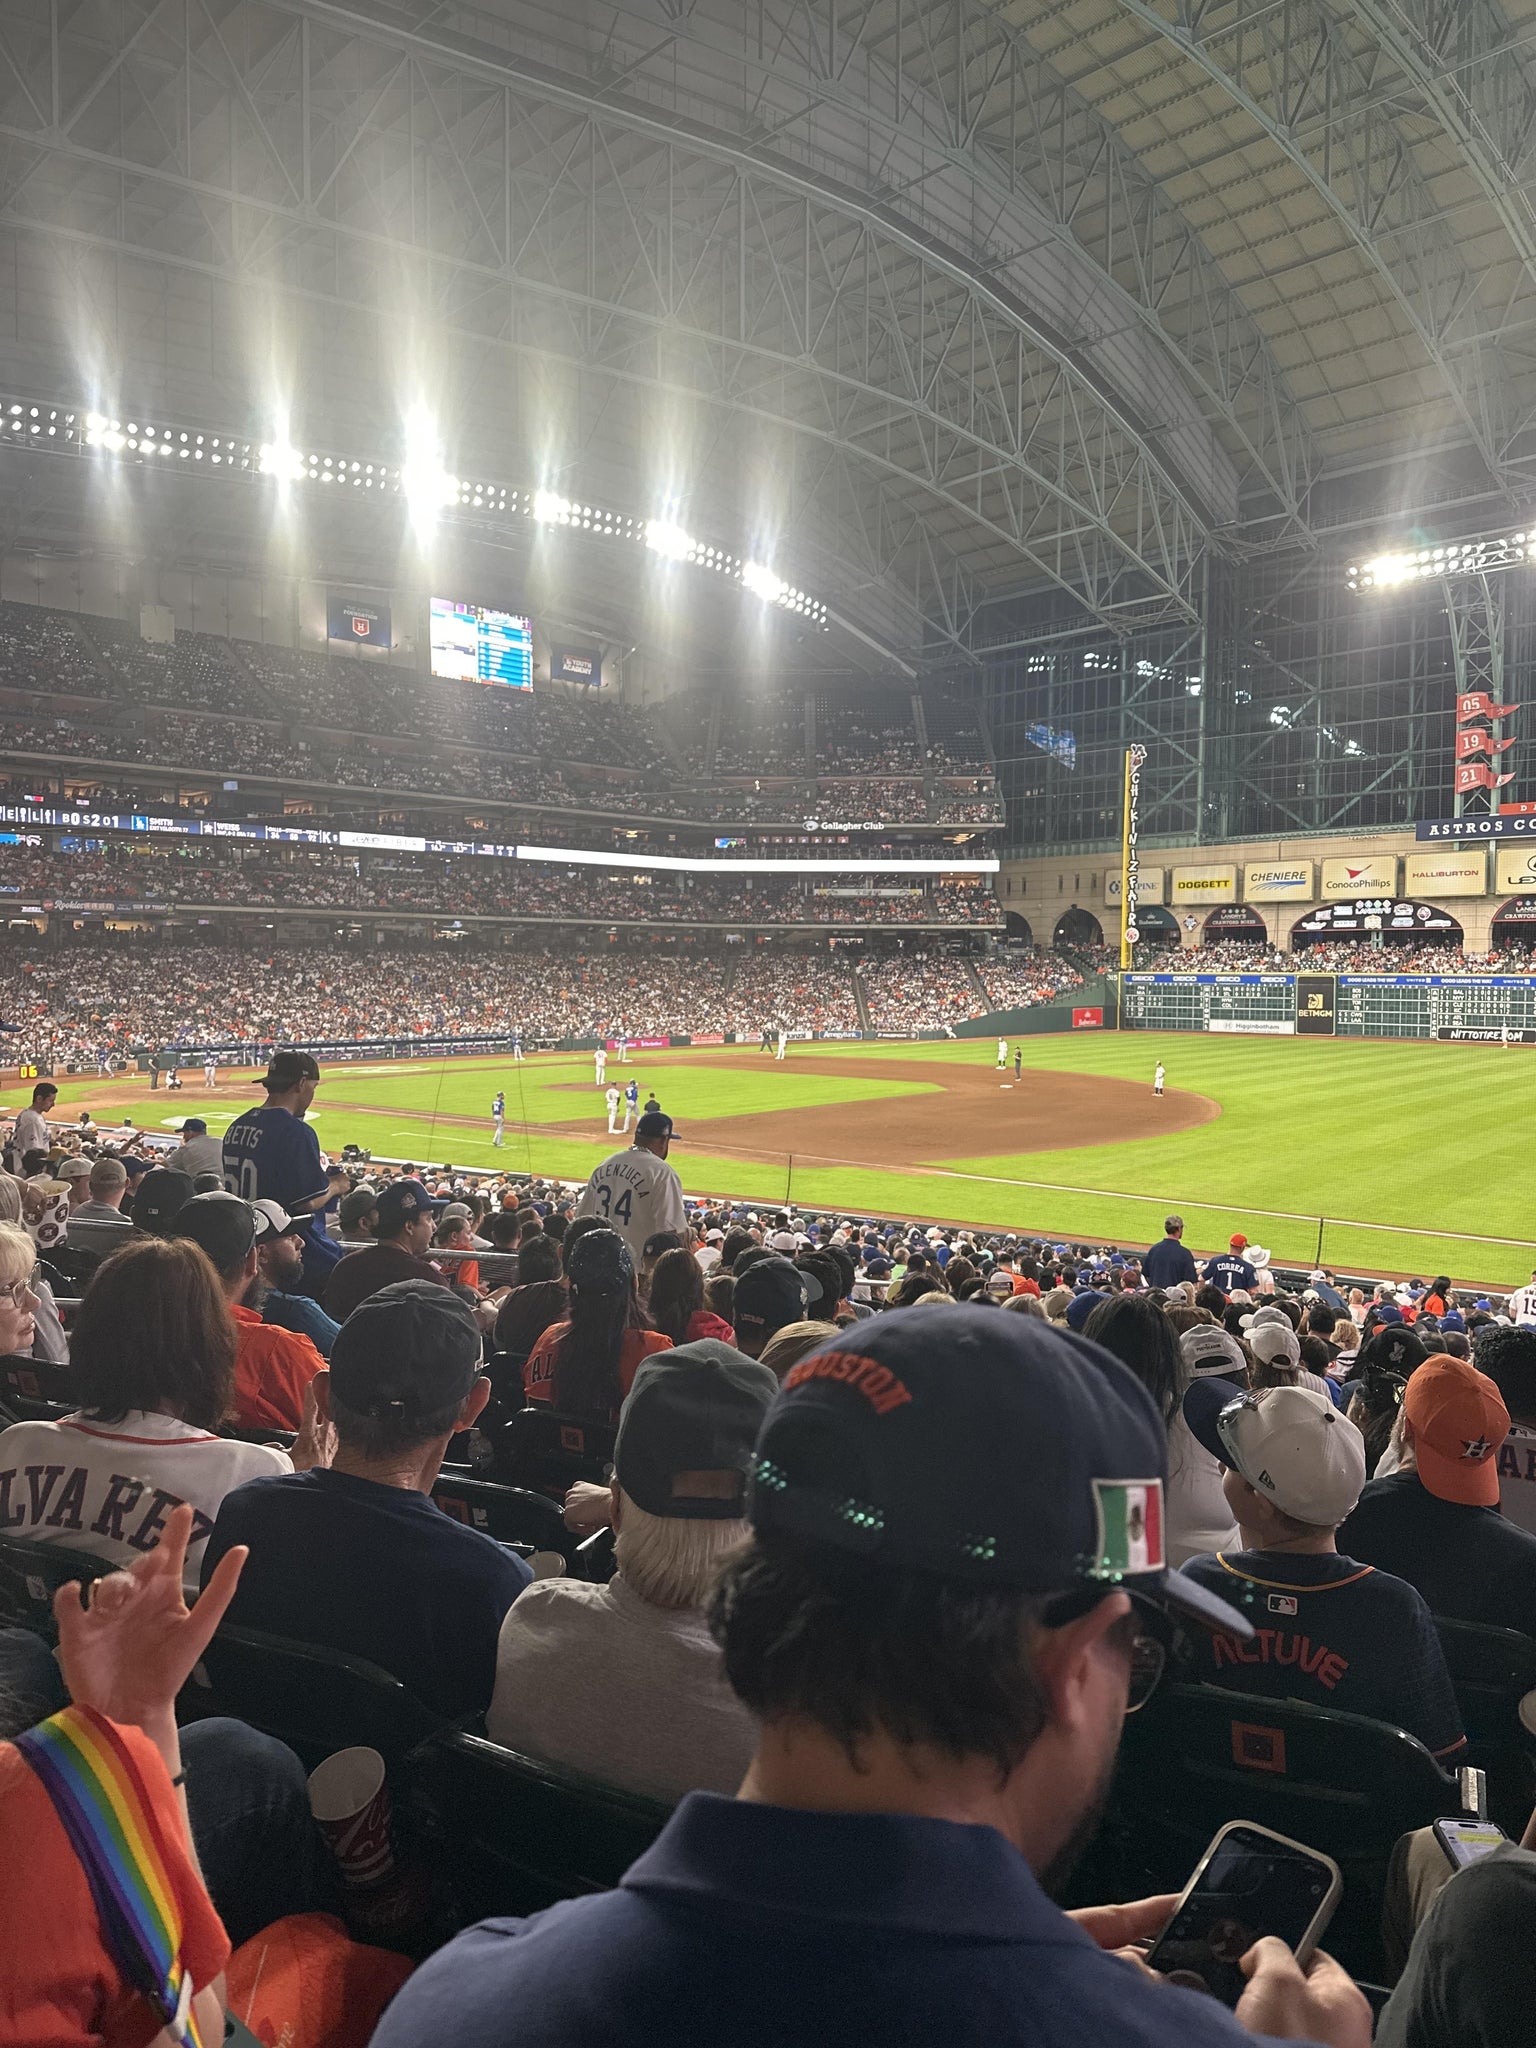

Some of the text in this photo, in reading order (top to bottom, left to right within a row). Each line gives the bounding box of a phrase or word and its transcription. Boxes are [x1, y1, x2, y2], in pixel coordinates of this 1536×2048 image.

[563, 664, 592, 675] ACADEMY
[1463, 698, 1480, 713] 05
[1463, 735, 1479, 750] 19
[1461, 769, 1477, 783] 21
[149, 817, 174, 826] SMITH
[217, 822, 241, 832] WEISS
[820, 822, 885, 831] Gallagher Club
[1429, 820, 1503, 836] ASTROS
[1250, 871, 1307, 882] CHENIERE
[1412, 870, 1479, 878] HALLIBURTON
[1178, 880, 1230, 889] DOGGETT
[1326, 880, 1391, 889] ConocoPhillips
[1298, 1009, 1333, 1017] BETMGM
[823, 1030, 859, 1040] AmegyBank
[20, 1065, 38, 1079] 06
[224, 1125, 263, 1149] BETTS
[223, 1155, 258, 1202] 50
[597, 1185, 633, 1226] 34
[1216, 1262, 1245, 1275] CORREA
[1225, 1271, 1233, 1290] 1
[1211, 1628, 1349, 1690] ALTUVE
